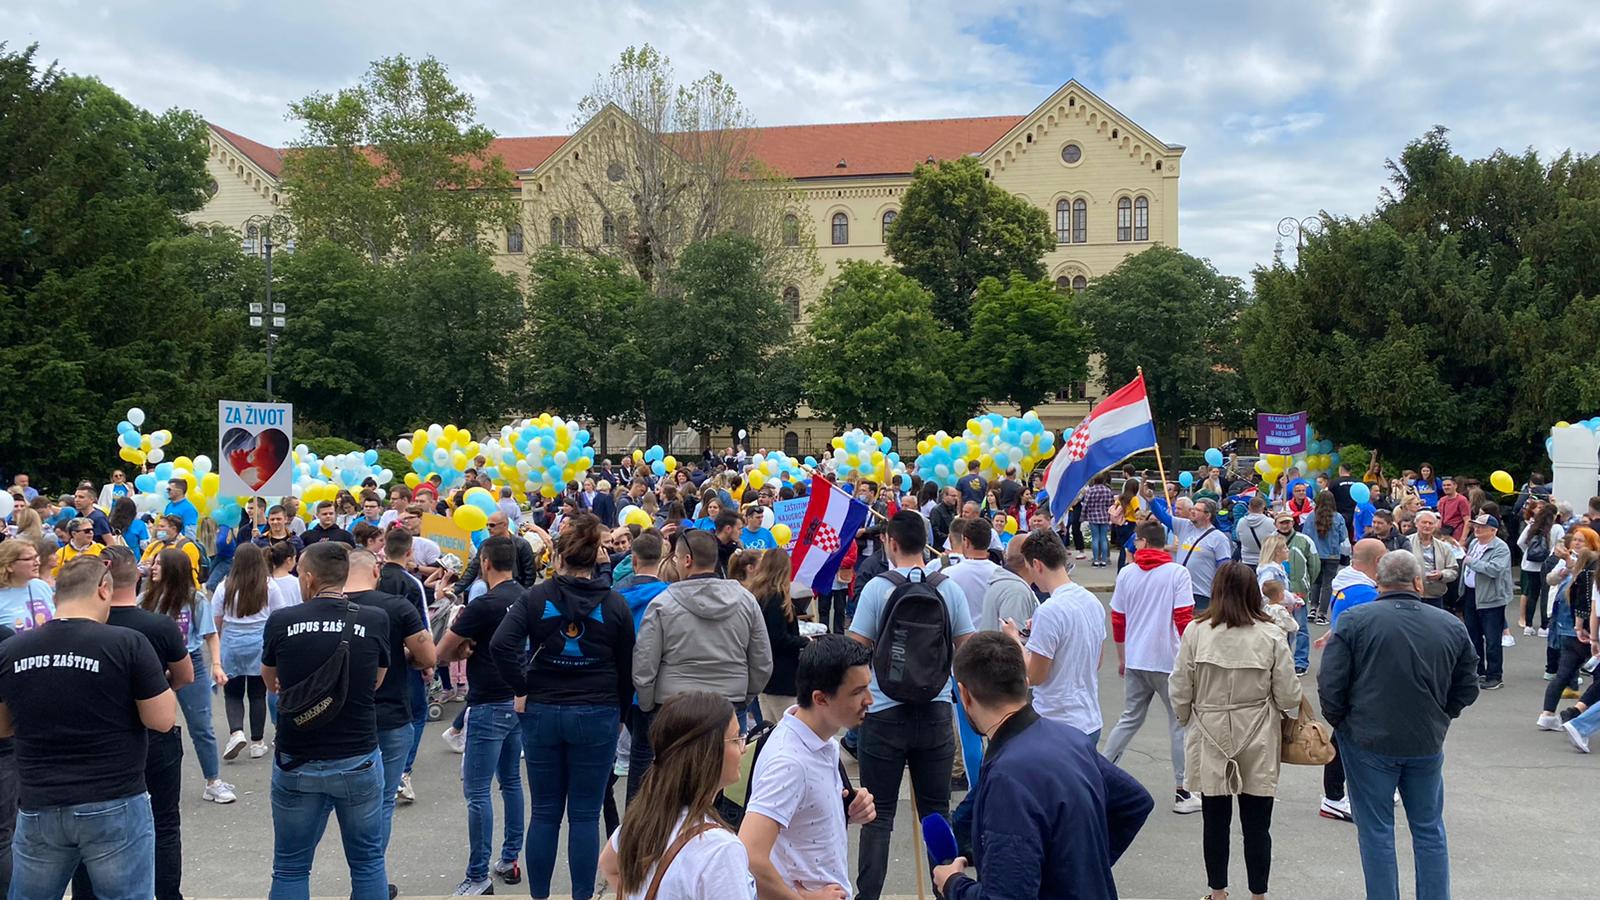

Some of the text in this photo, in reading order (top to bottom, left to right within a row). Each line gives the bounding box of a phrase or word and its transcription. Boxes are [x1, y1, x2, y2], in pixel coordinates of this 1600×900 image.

[225, 404, 285, 425] ZA ŽIVOT
[287, 619, 366, 638] LUPUS ZAŠTA
[891, 630, 908, 662] PUMA
[14, 652, 100, 674] LUPUS ZAŠTITA
